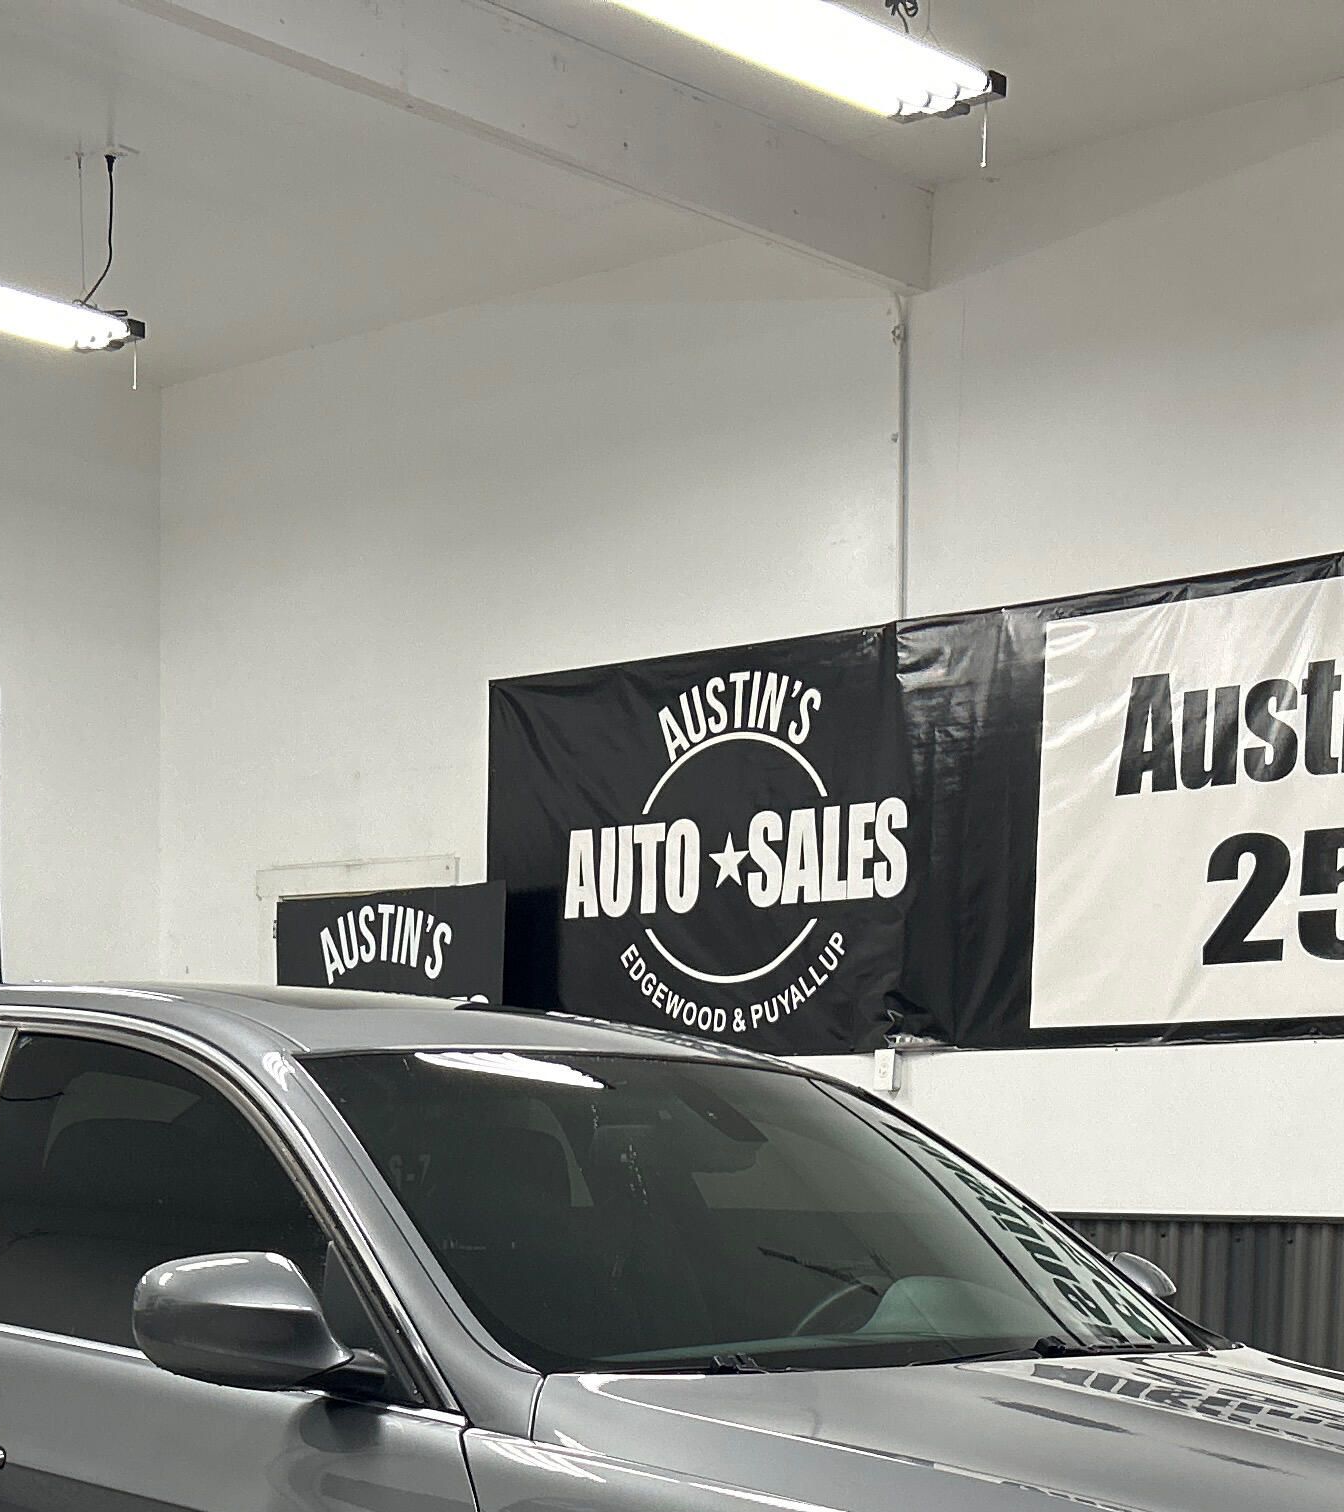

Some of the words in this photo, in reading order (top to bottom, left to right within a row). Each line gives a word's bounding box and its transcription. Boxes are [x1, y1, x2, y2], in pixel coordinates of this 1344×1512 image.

[657, 669, 823, 763] AUSTIN'S
[564, 817, 699, 921] AUTO
[746, 797, 909, 909] SALES
[319, 903, 453, 986] AUSTIN'S
[618, 943, 727, 1033] EDGEWOOD
[732, 1010, 748, 1031] &
[750, 931, 847, 1030] PUYALLUP
